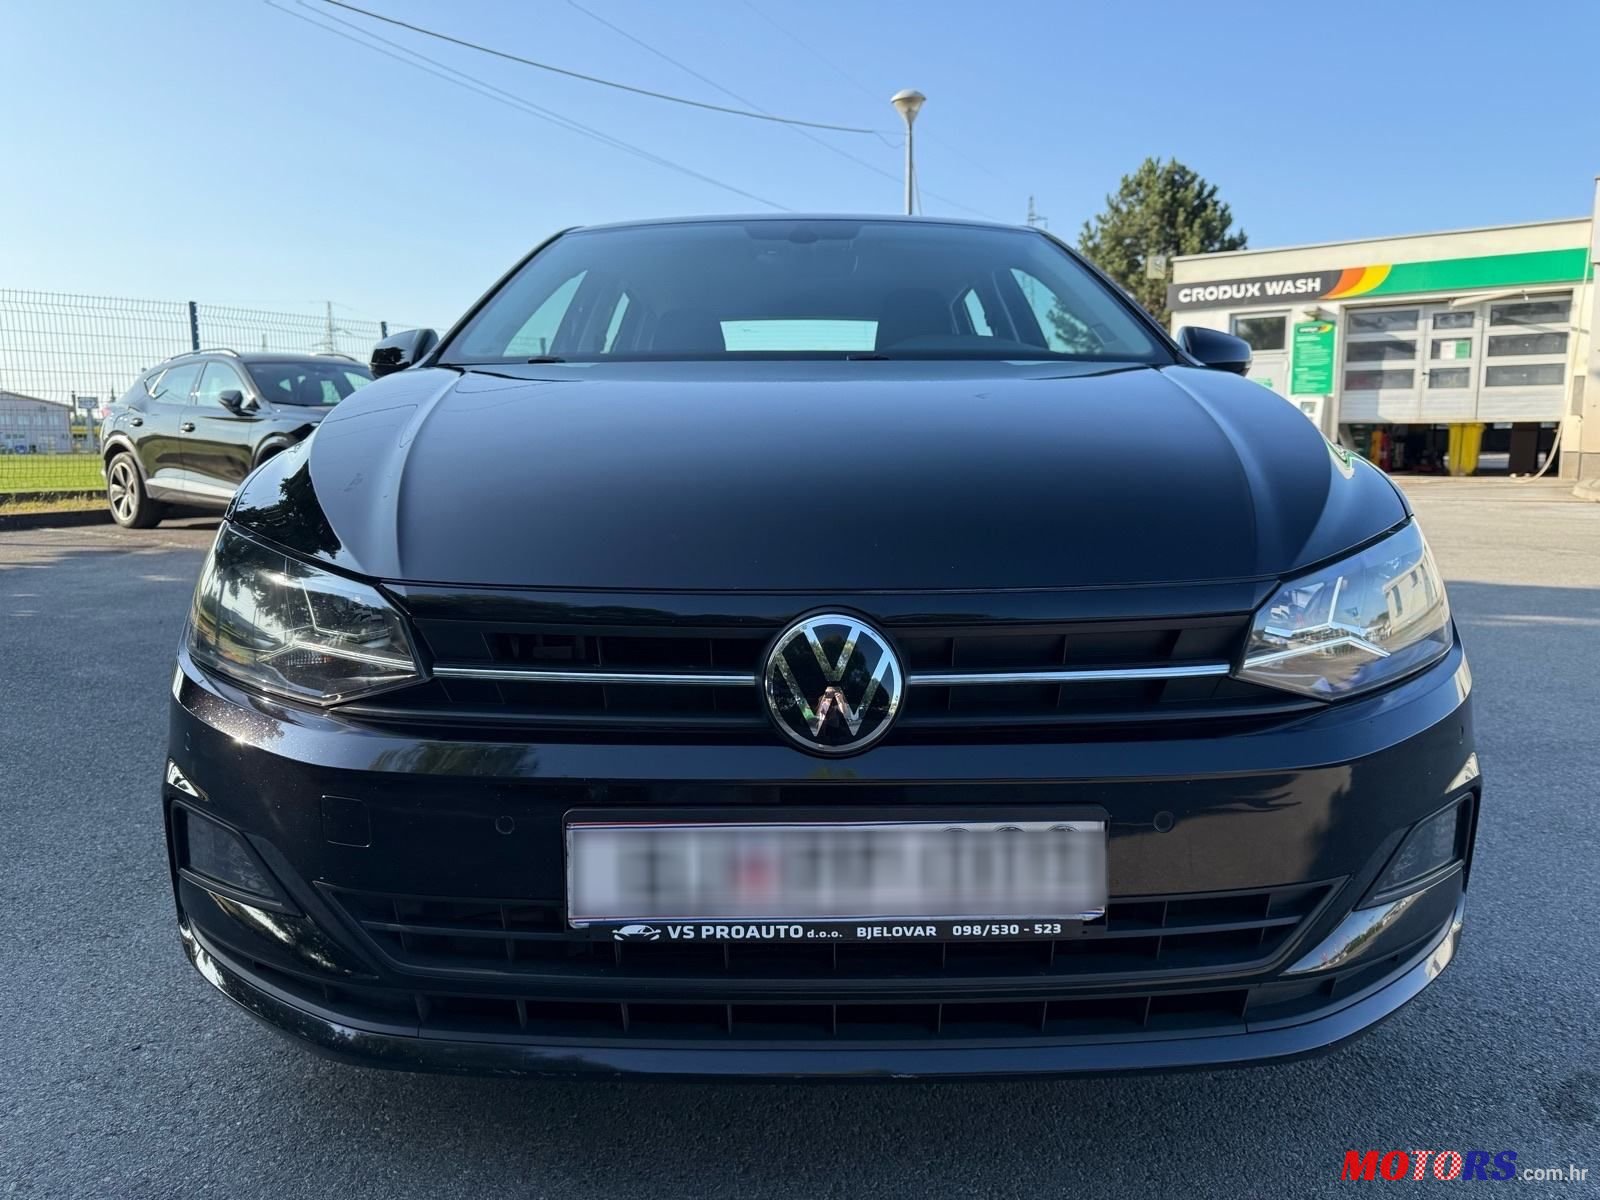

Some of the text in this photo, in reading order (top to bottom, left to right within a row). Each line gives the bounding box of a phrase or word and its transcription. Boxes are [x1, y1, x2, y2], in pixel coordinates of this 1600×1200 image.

[1178, 277, 1321, 303] CRODUX WASH
[667, 925, 695, 939] VS
[701, 925, 803, 939] PROAUTO
[807, 929, 843, 938] d.o.o.
[856, 926, 937, 940] BJELOVAR
[952, 924, 1019, 937] 098/530
[1034, 923, 1062, 935] 523
